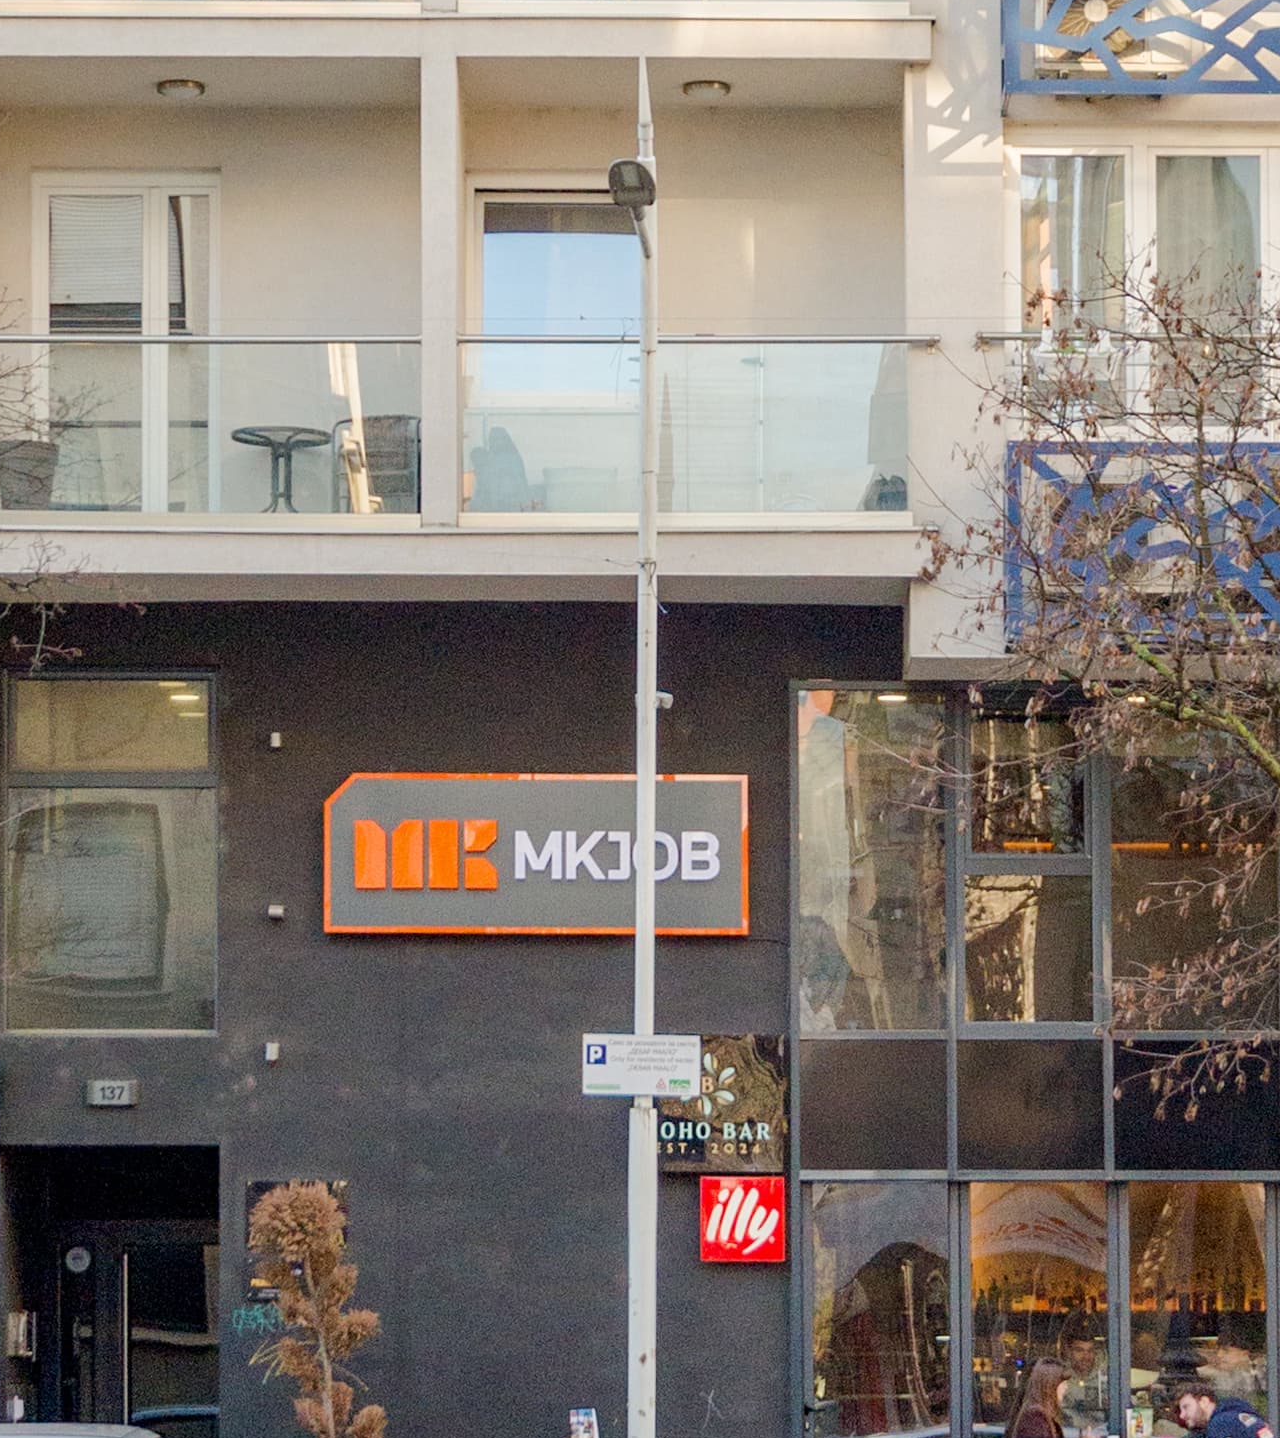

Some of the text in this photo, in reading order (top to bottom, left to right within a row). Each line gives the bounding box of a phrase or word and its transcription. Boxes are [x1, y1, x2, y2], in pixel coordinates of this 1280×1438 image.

[514, 829, 721, 881] MKJOB
[100, 1086, 125, 1100] 137
[660, 1121, 770, 1140] OHO BAR
[711, 1142, 762, 1154] 2024
[705, 1186, 781, 1255] illy
